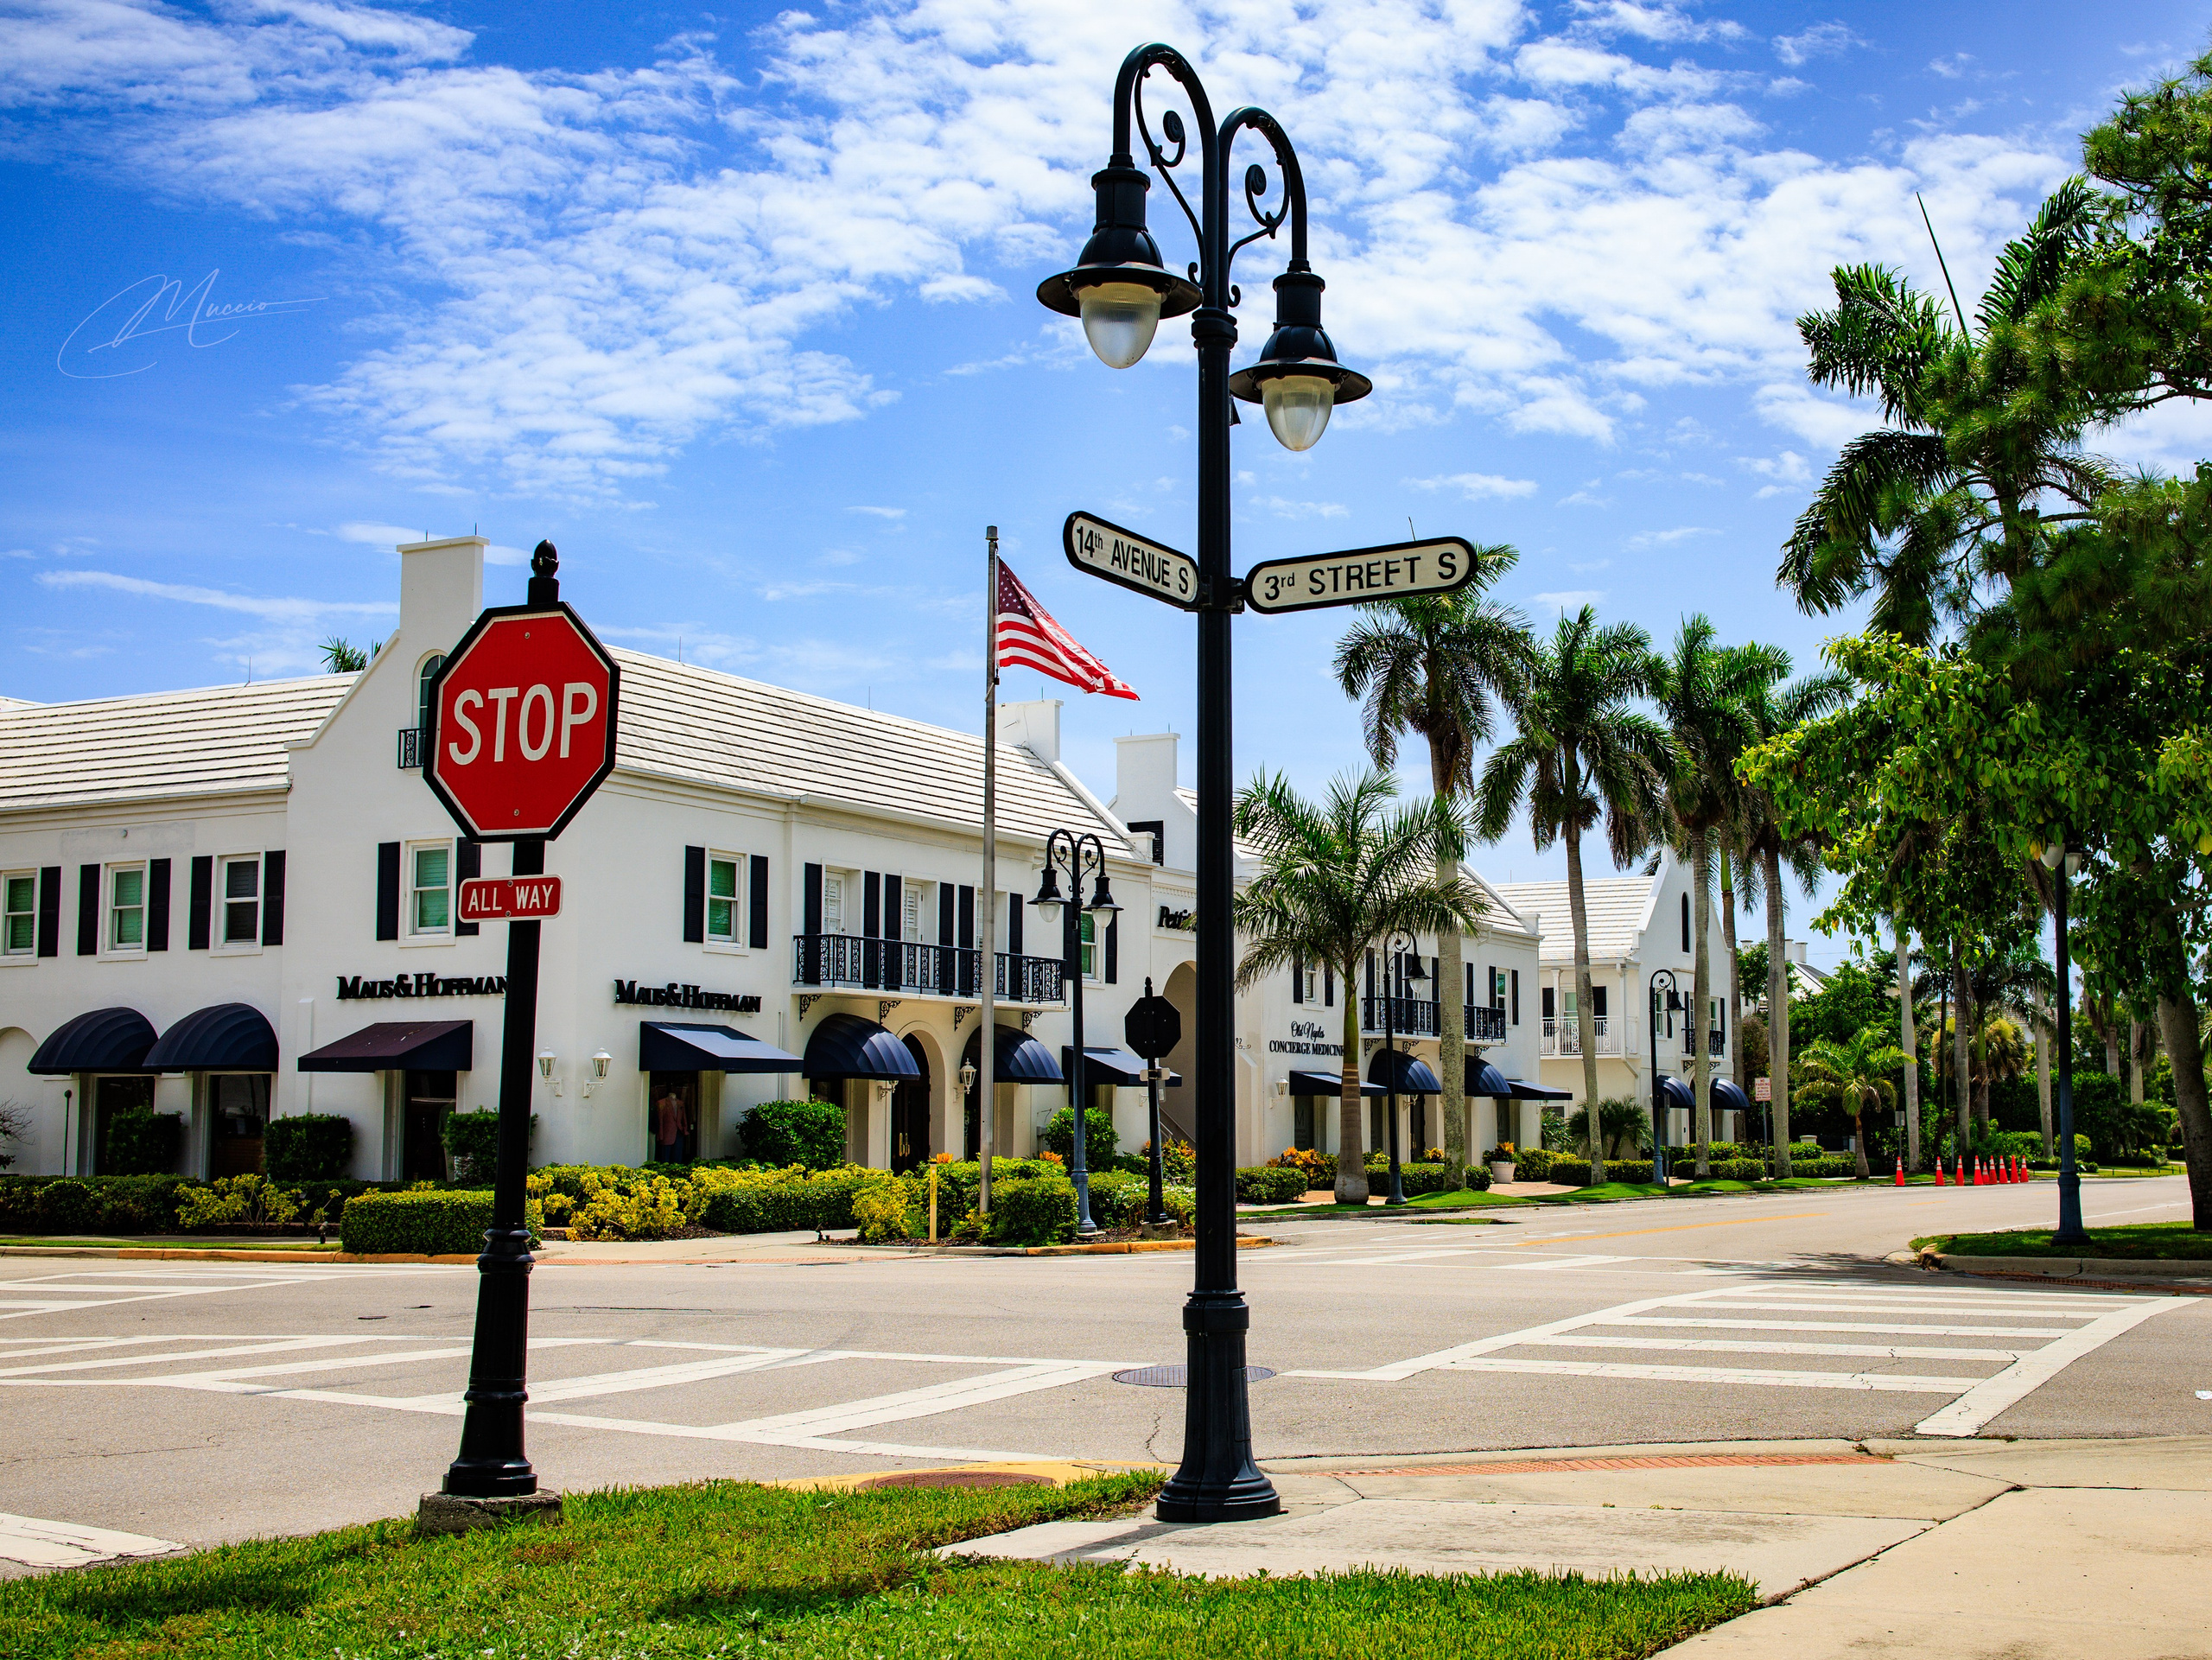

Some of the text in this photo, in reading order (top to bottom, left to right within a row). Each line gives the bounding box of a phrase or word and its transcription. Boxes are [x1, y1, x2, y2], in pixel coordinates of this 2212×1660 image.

[1077, 525, 1189, 595] 14th AVENUE S
[1264, 572, 1295, 601] 3rd
[1438, 552, 1457, 580] S
[448, 682, 598, 766] STOP
[467, 884, 554, 912] ALL WAY
[1269, 1040, 1311, 1054] CONCIERGE
[1290, 1021, 1304, 1037] Old
